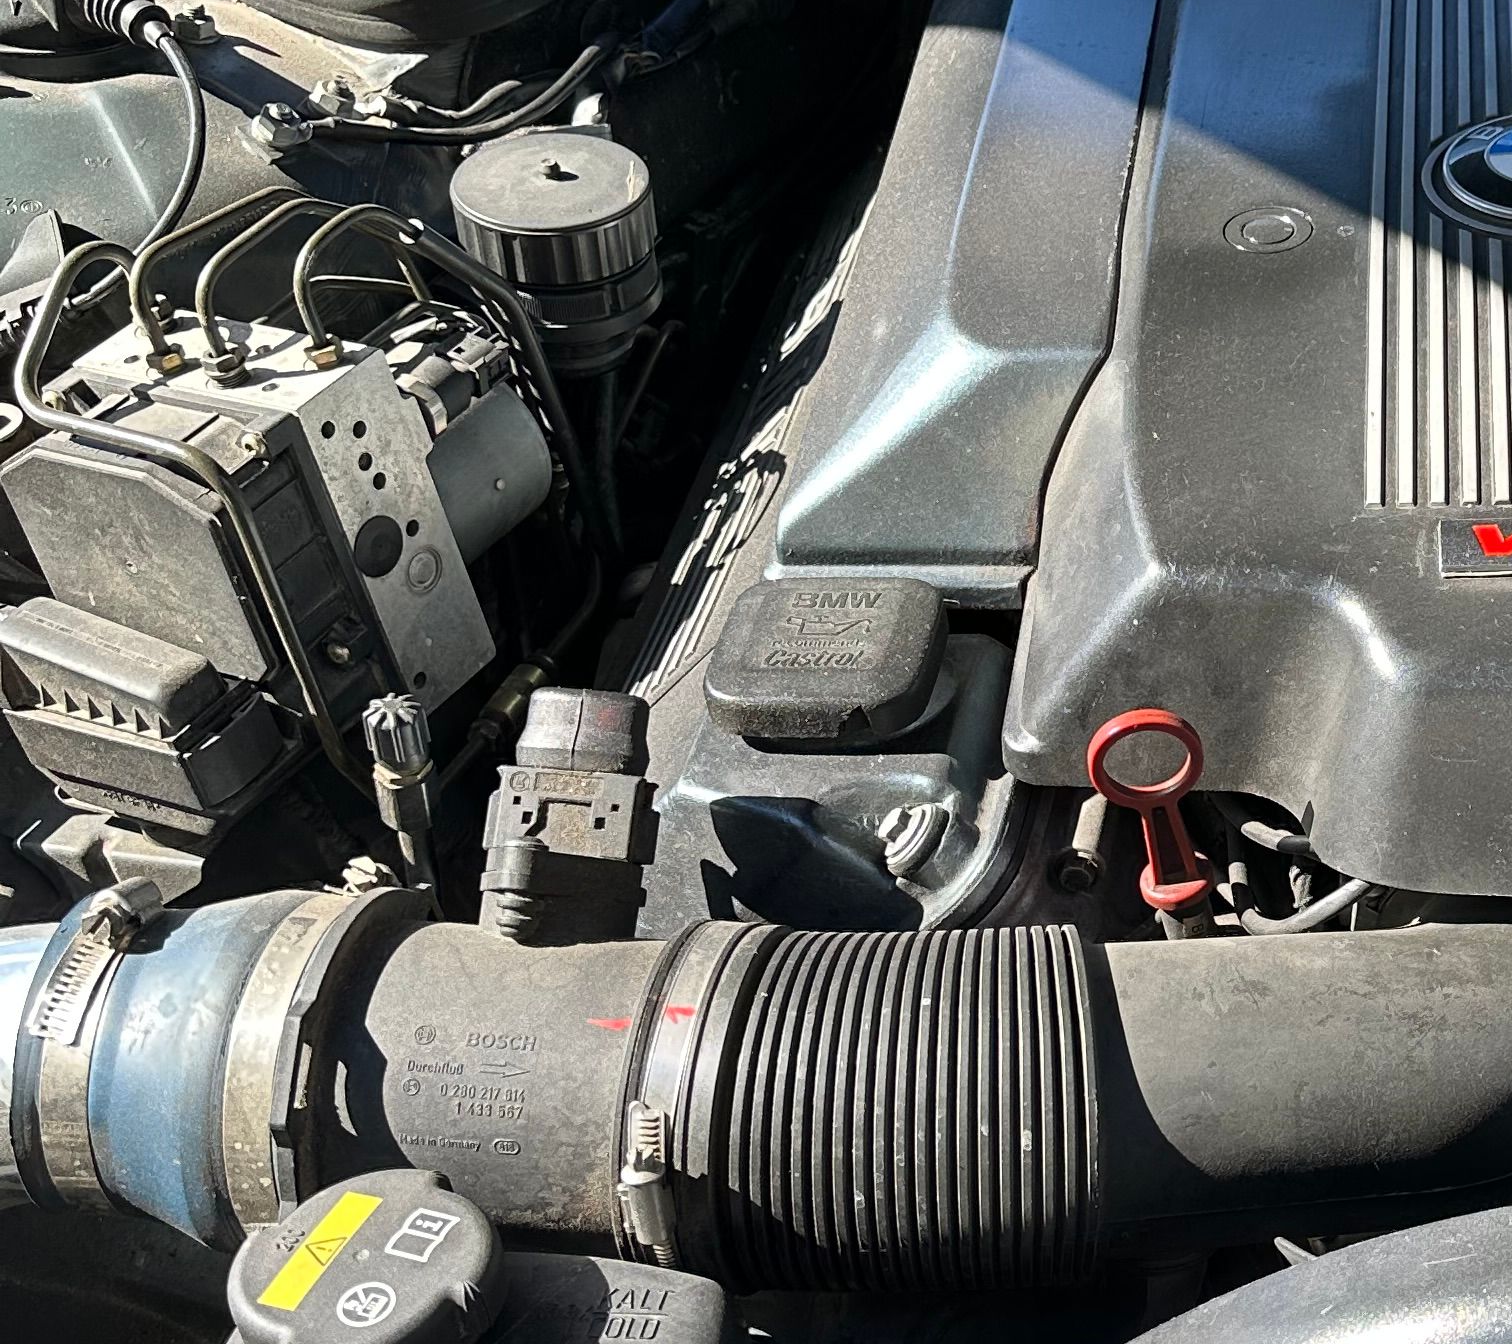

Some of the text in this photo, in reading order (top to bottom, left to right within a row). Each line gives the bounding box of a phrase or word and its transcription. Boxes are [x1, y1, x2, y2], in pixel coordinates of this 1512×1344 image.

[792, 592, 882, 609] BMW
[763, 649, 865, 668] Castrol
[466, 1032, 537, 1052] BOSCH
[440, 1083, 449, 1097] 0
[480, 1086, 502, 1101] 217
[456, 1101, 524, 1120] 1 433 567
[599, 1288, 676, 1311] KALT
